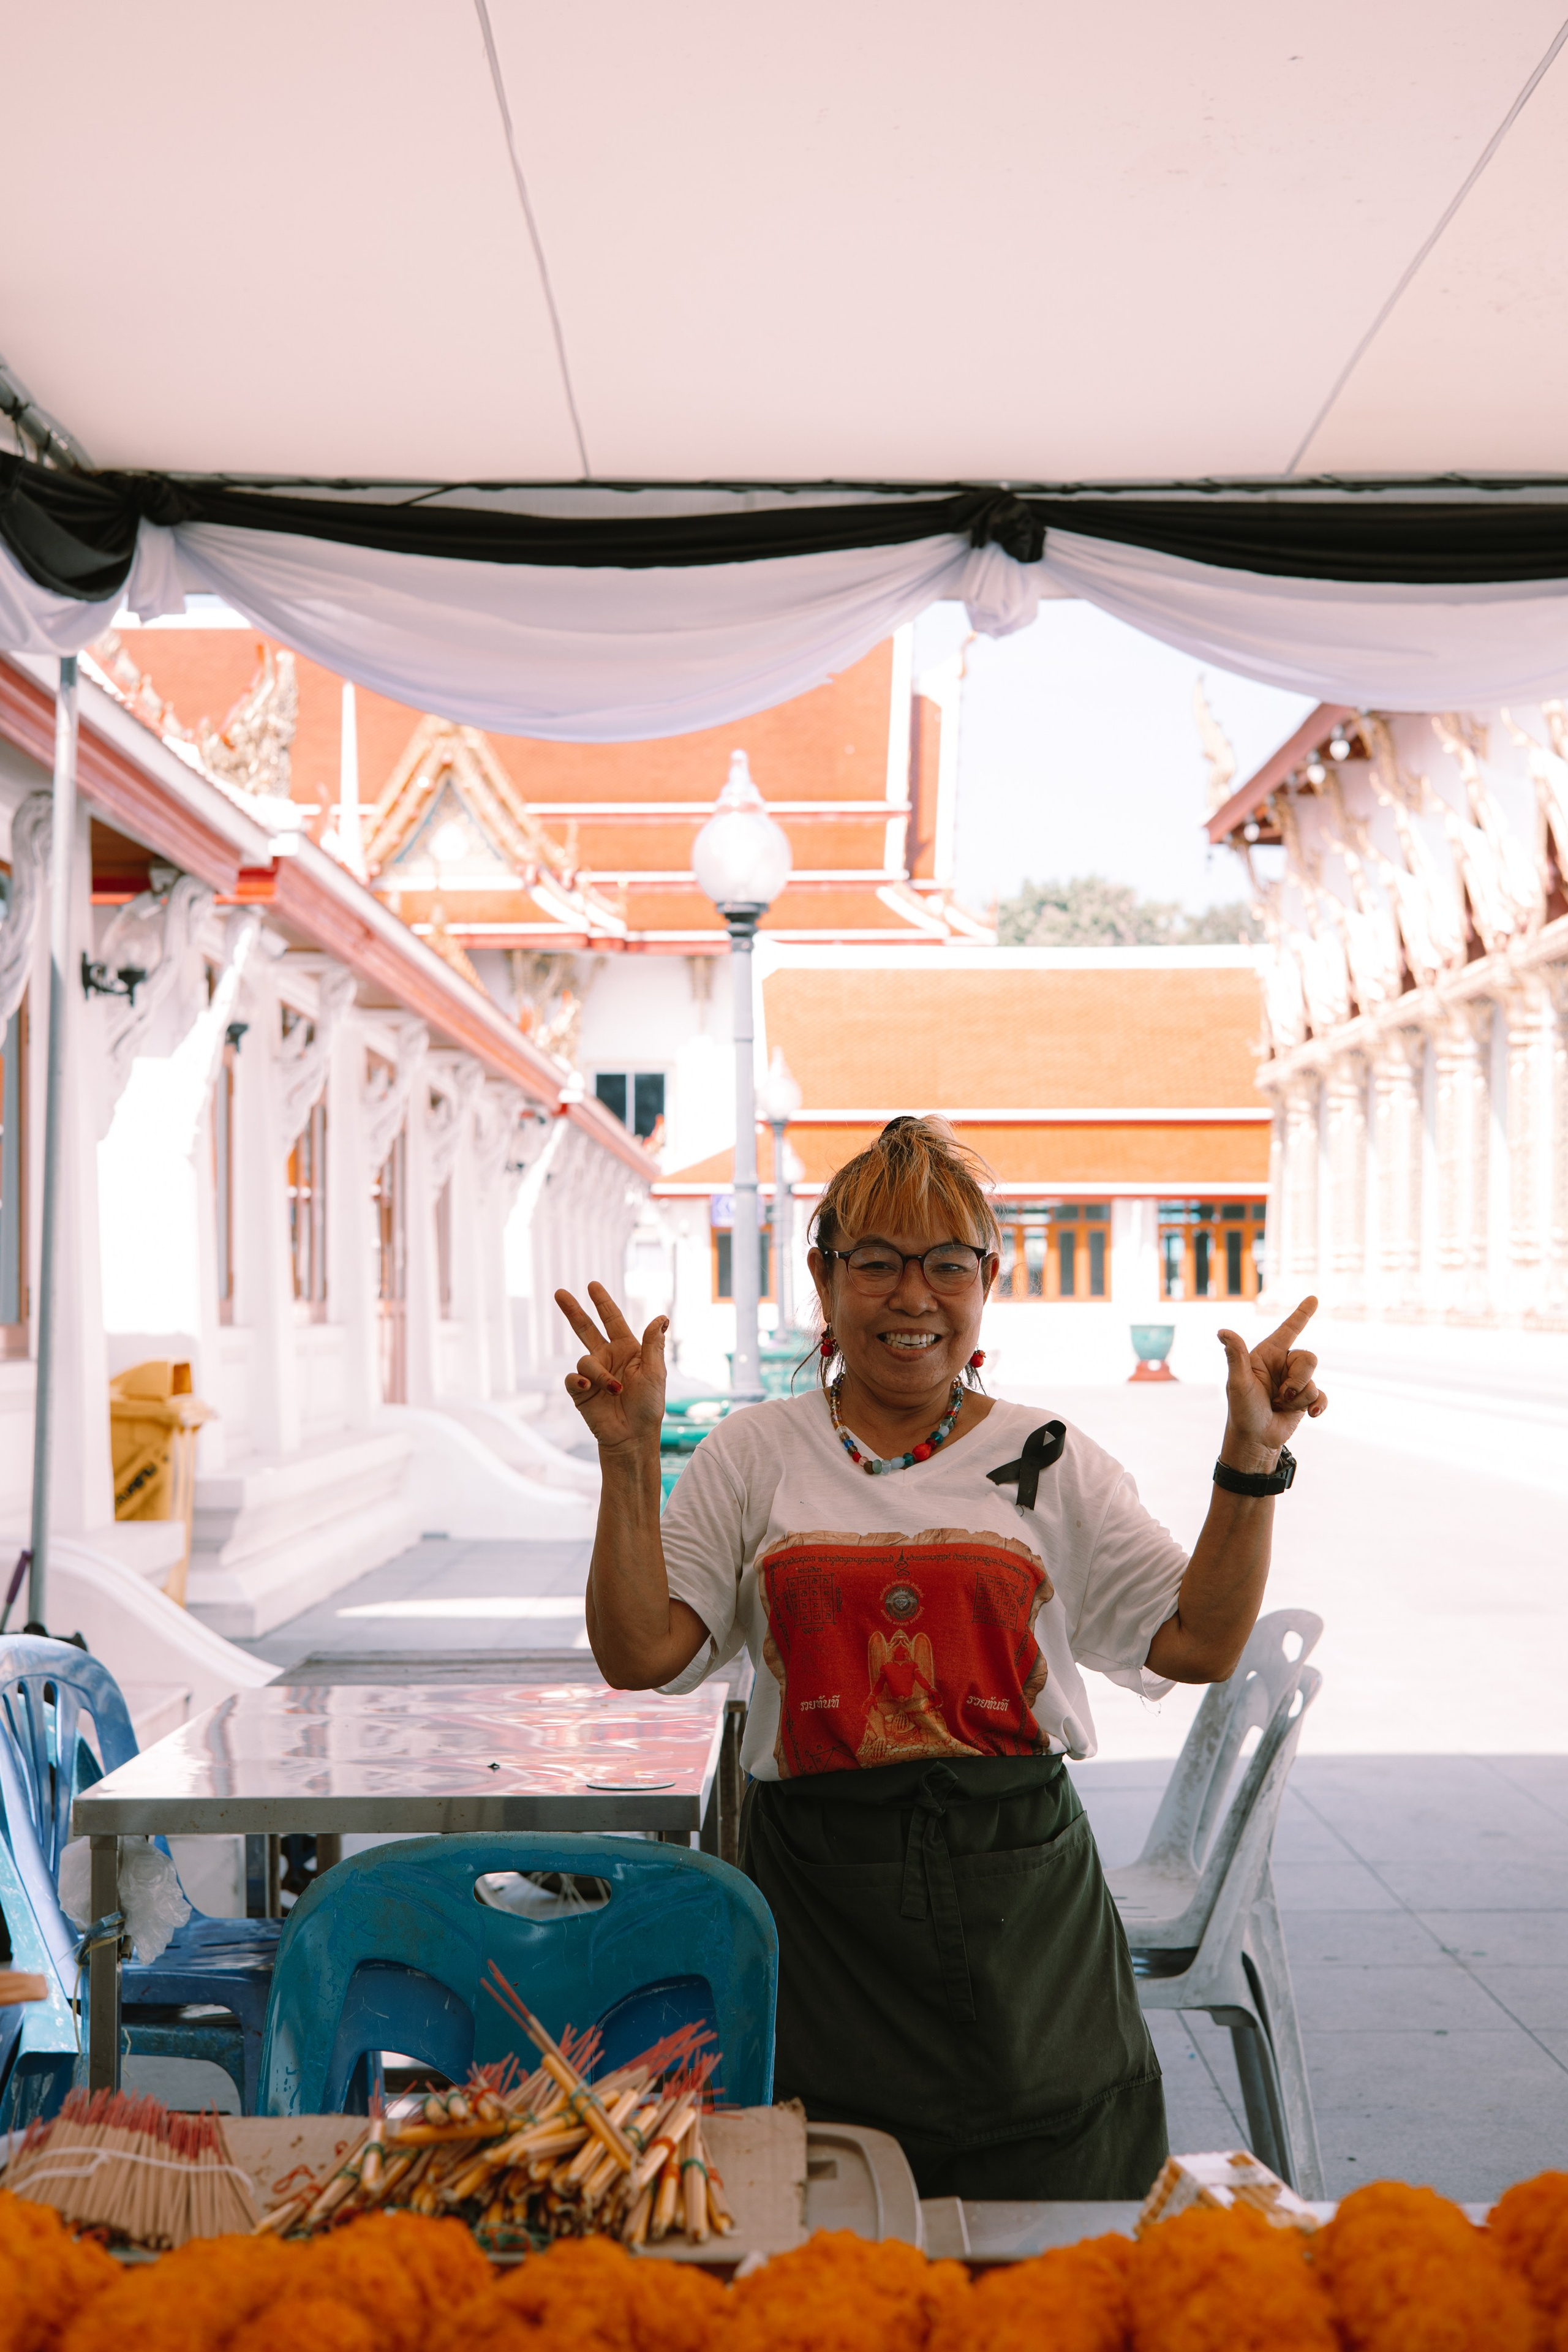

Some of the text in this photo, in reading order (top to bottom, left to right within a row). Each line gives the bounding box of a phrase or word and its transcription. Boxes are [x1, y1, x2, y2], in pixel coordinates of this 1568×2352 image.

[799, 1695, 840, 1711] รวยทันที
[966, 1695, 1010, 1712] รวยทันที
